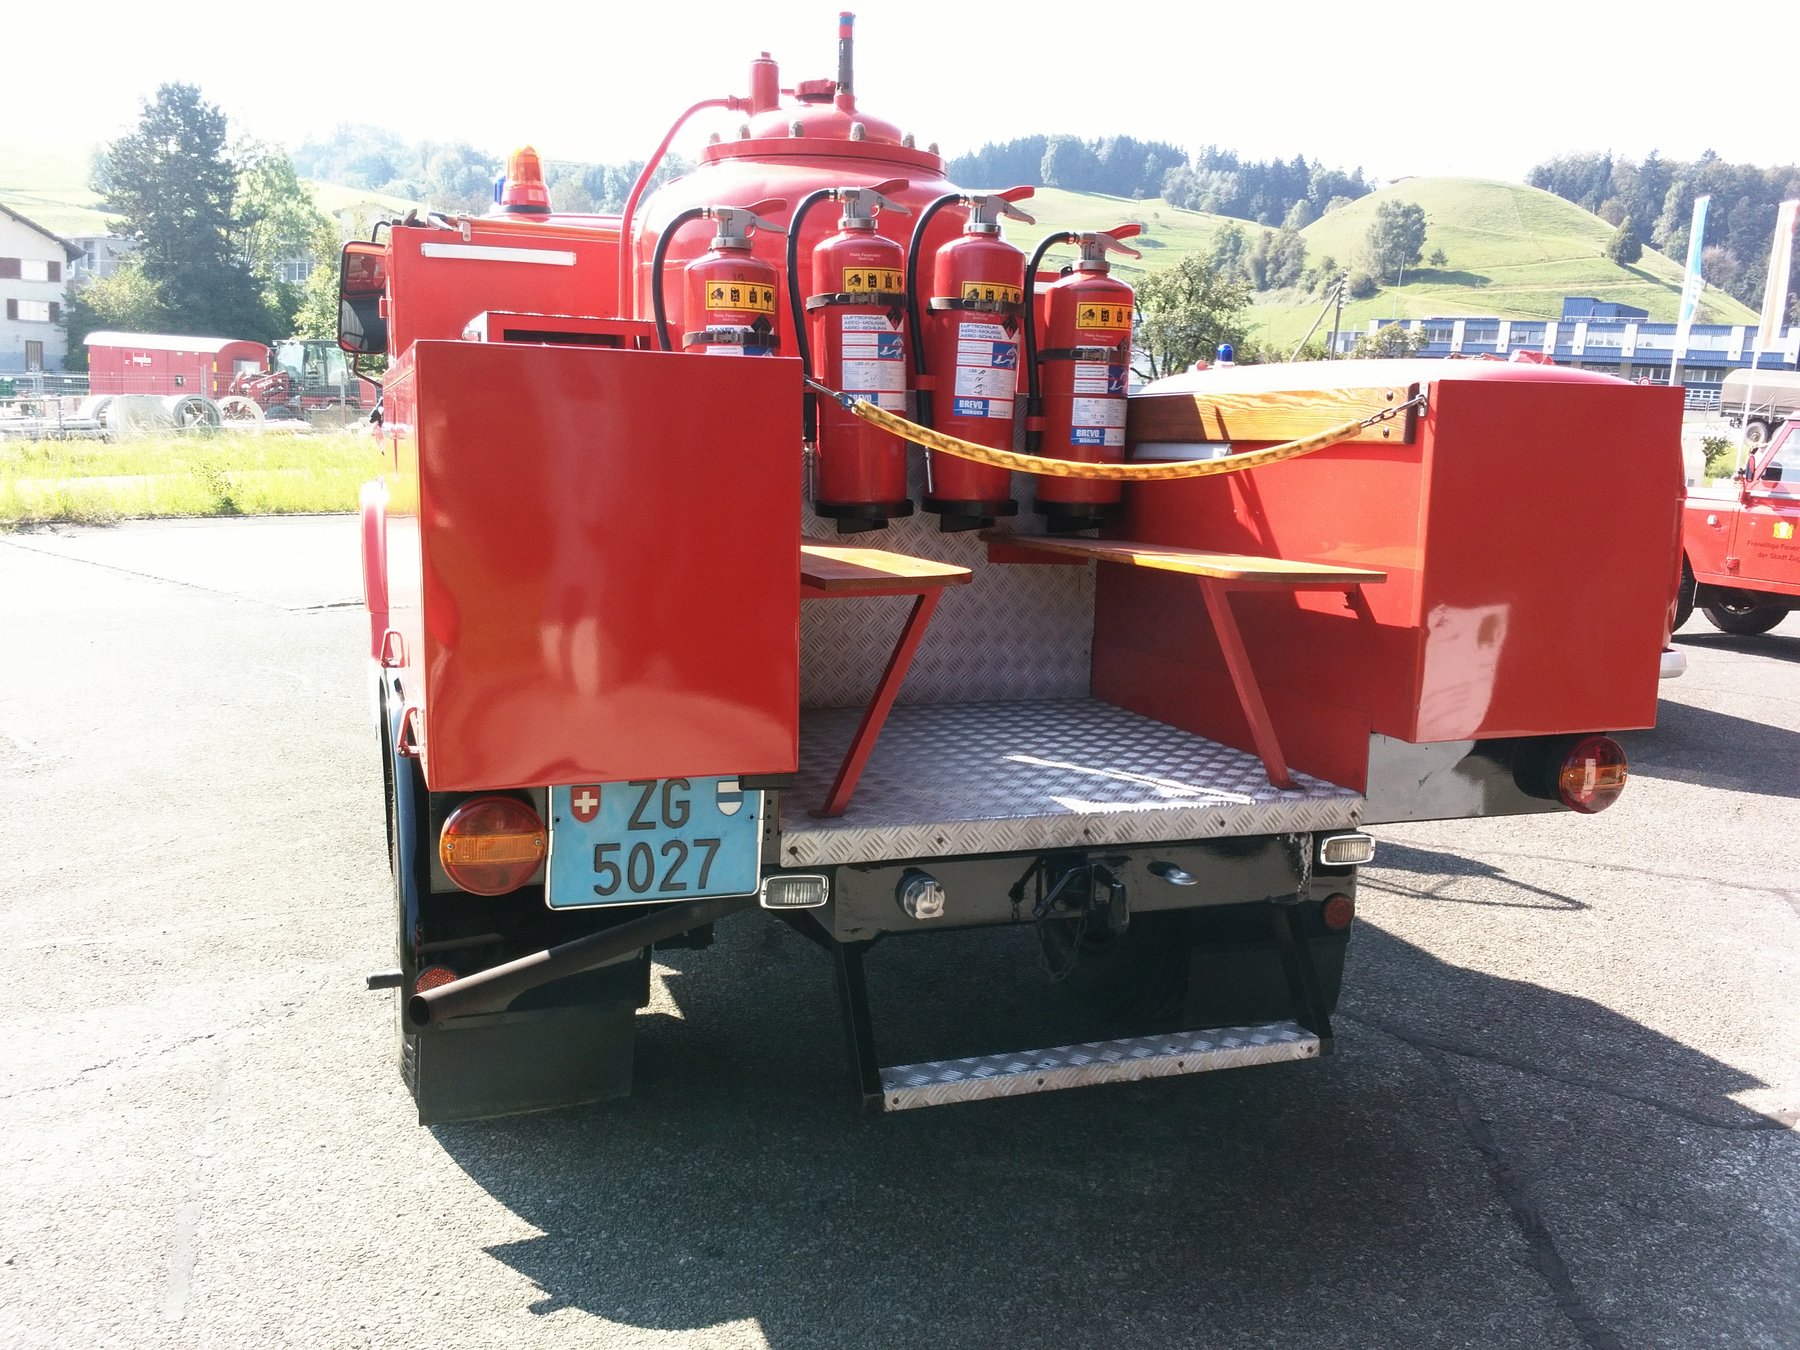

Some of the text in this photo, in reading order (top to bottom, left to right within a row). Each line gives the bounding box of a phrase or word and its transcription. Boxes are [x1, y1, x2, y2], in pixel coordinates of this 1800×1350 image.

[959, 399, 983, 409] BREVO
[1076, 429, 1100, 438] BREVO
[1747, 540, 1779, 550] Freiwillige
[1770, 553, 1787, 561] Stadt
[628, 778, 691, 831] ZG
[594, 838, 721, 896] 5027
